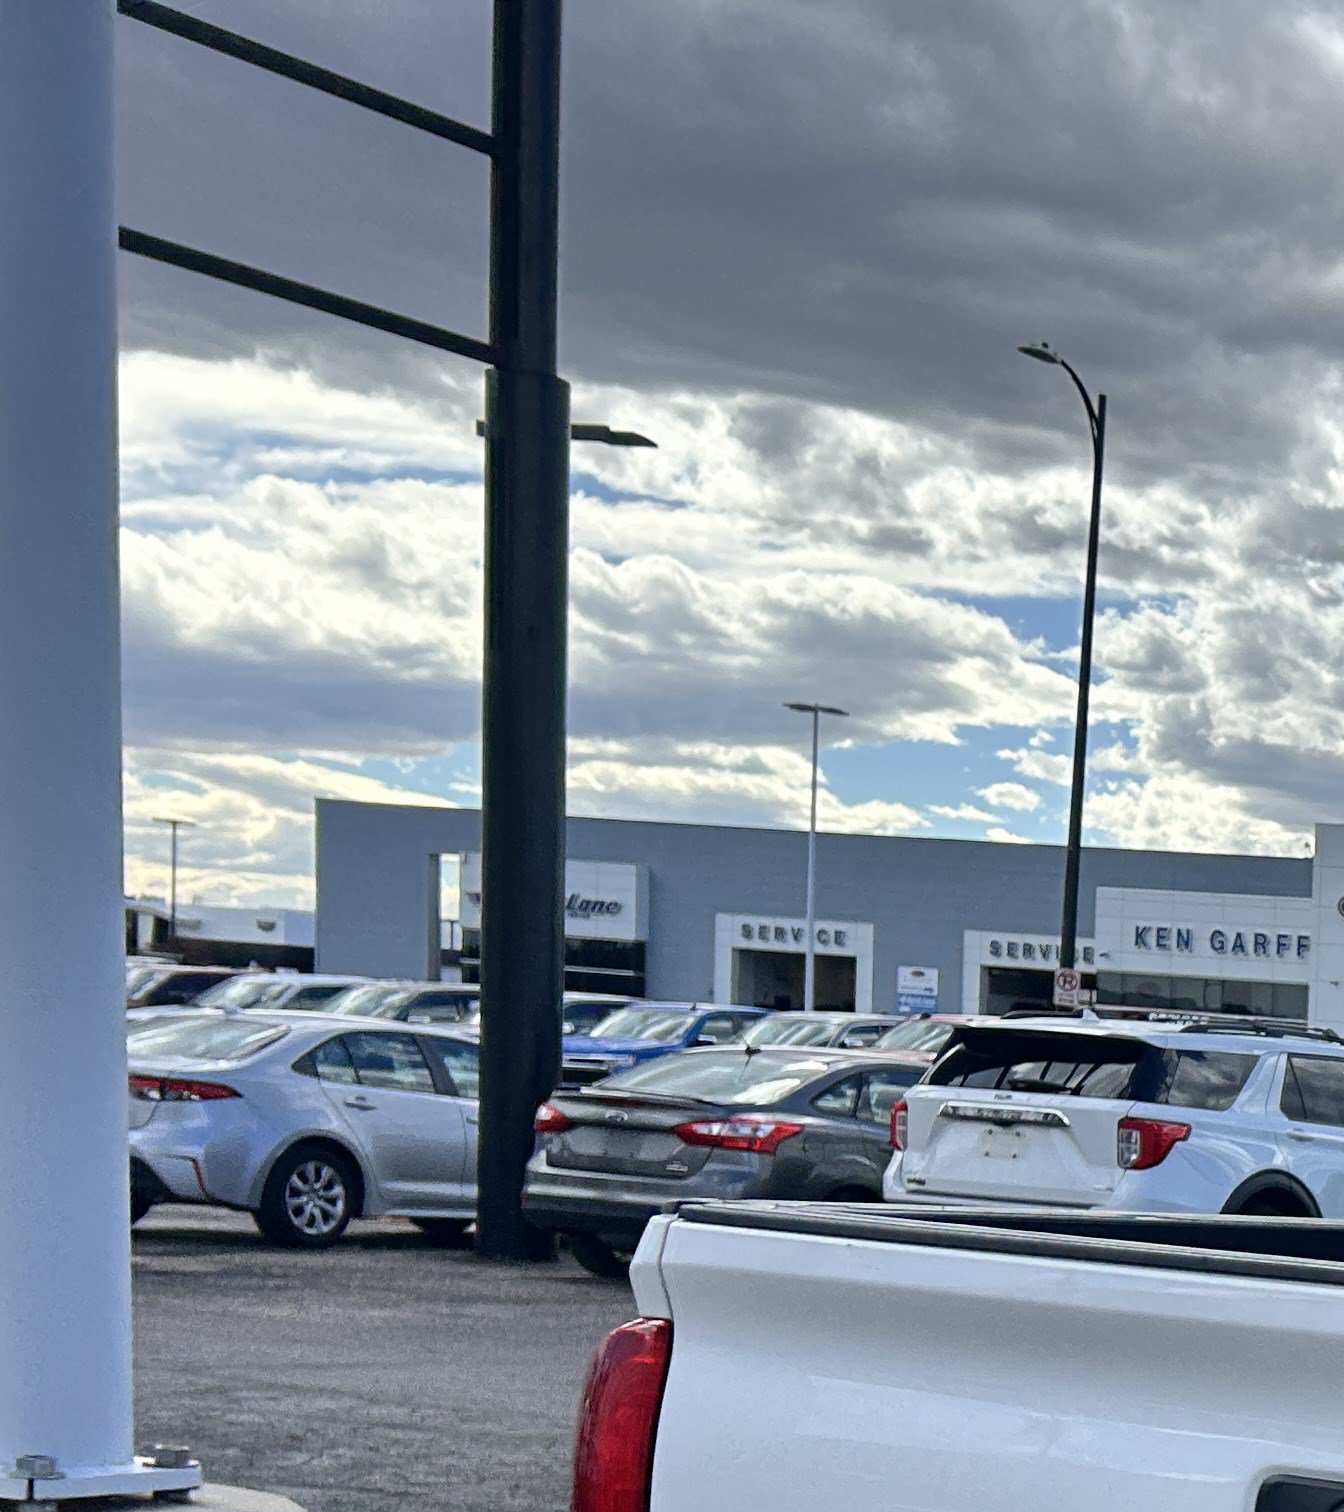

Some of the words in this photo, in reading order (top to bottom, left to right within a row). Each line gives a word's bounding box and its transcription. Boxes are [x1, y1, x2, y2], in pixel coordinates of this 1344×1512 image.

[741, 923, 847, 947] SERVCE
[1134, 925, 1193, 951] KEN
[1209, 929, 1312, 958] GARFF
[990, 939, 1095, 965] SERVIE
